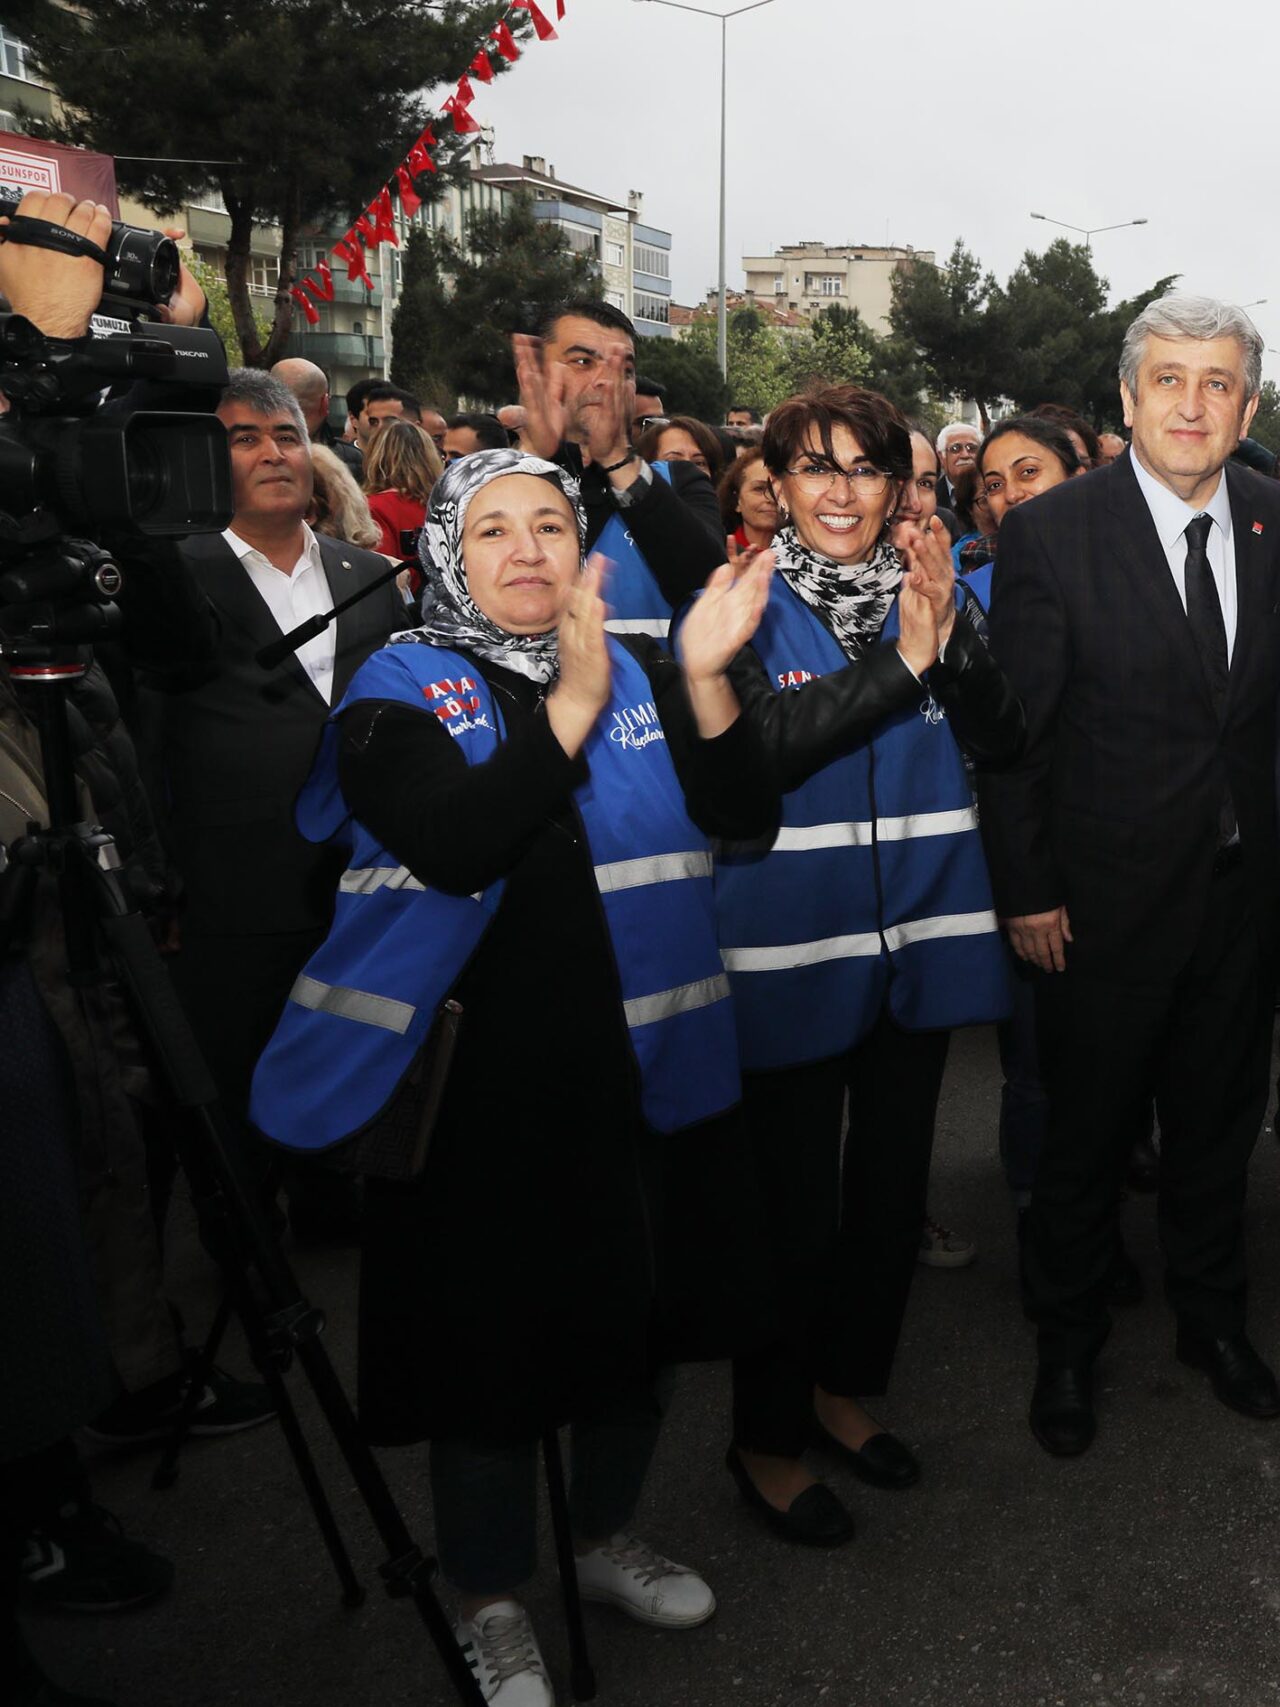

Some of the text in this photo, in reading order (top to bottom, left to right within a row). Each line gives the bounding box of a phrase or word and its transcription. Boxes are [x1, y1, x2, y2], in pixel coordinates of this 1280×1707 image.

[0, 164, 47, 182] SUNSPOR
[50, 227, 83, 243] SONY
[777, 670, 820, 689] SAN
[612, 702, 660, 732] KEMA
